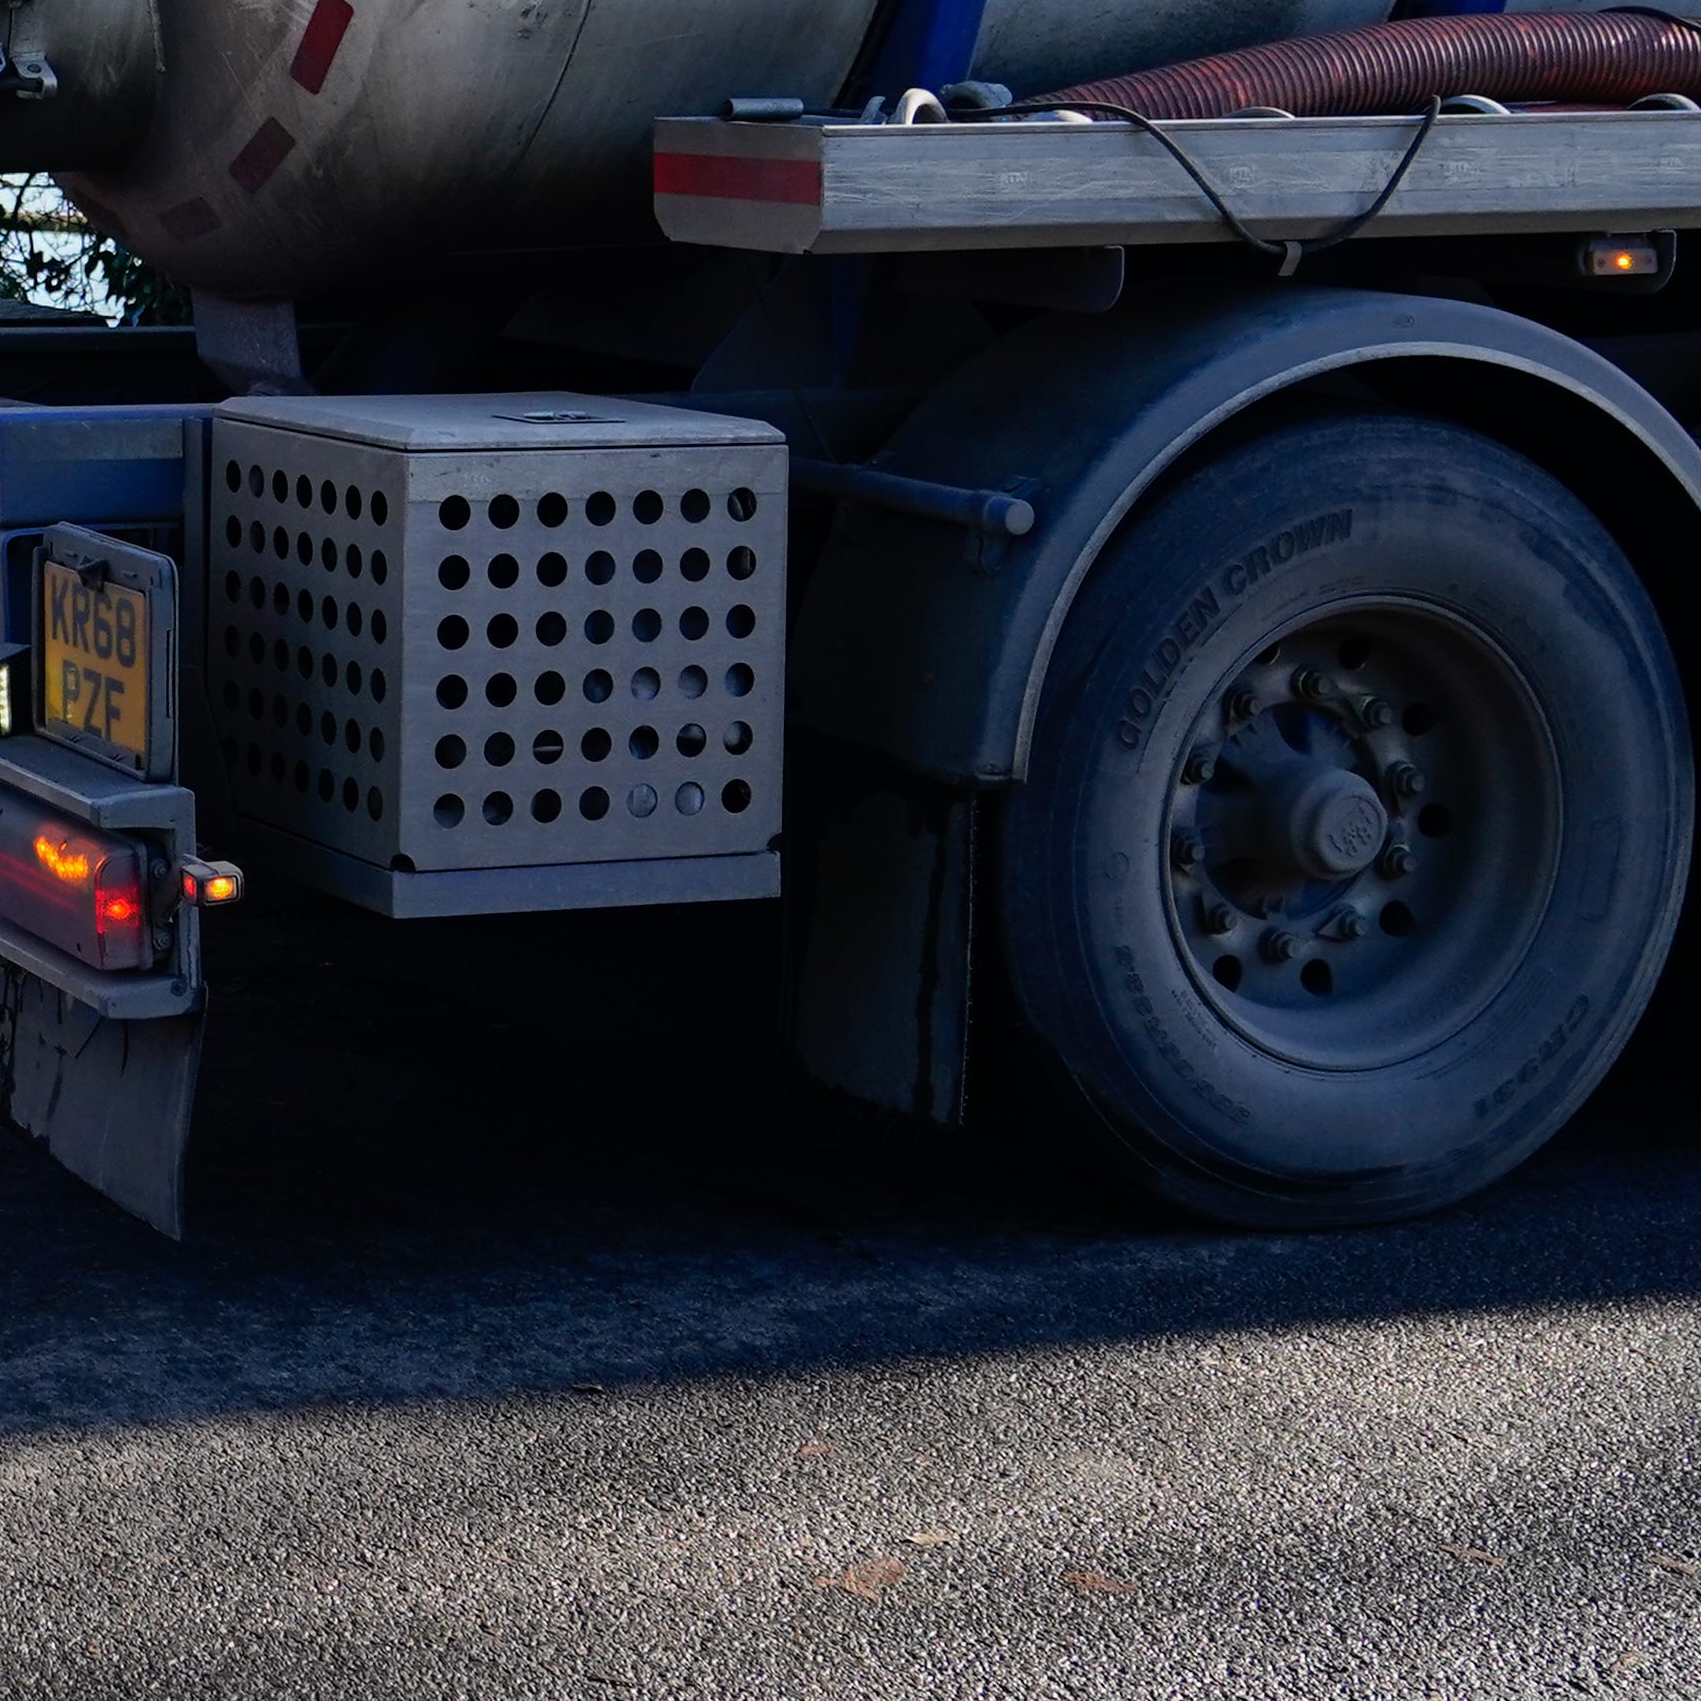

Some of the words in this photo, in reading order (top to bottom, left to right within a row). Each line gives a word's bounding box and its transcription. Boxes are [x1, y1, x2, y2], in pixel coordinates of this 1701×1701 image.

[49, 574, 138, 669] KR68
[1115, 585, 1222, 752] GOLDEN
[1222, 508, 1354, 596] CROWN
[61, 658, 125, 743] PZF
